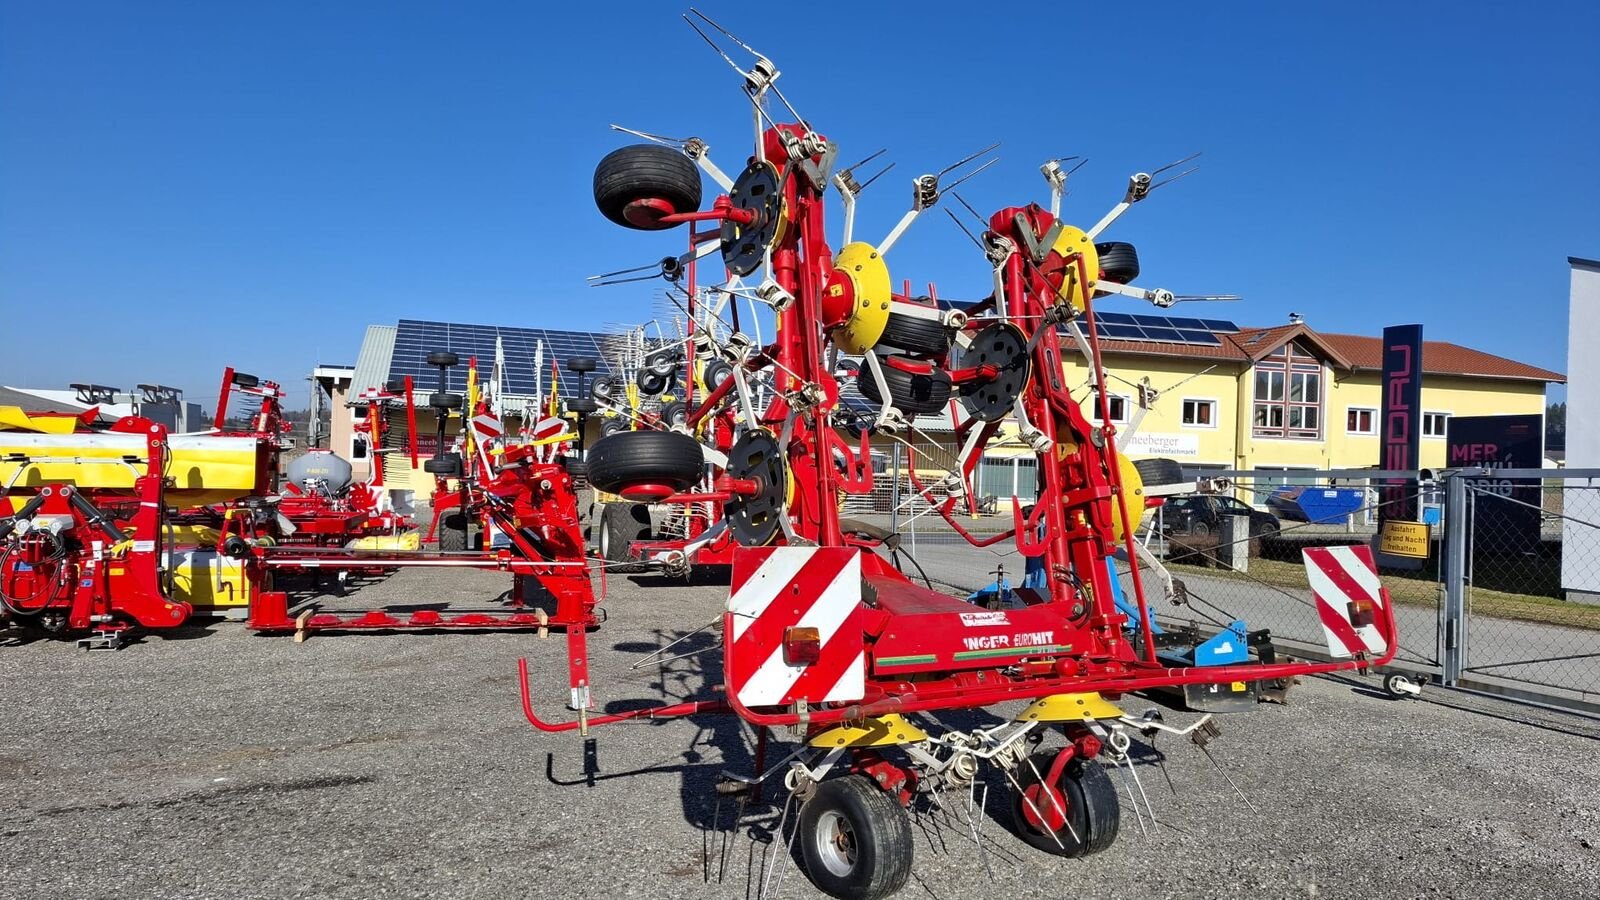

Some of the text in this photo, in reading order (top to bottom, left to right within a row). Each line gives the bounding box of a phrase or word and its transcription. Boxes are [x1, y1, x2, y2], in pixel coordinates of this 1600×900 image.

[1149, 447, 1196, 455] Elektrofachmarkt
[1452, 444, 1497, 461] MER
[1391, 525, 1416, 534] Ausfahrt
[1405, 536, 1426, 544] Nacht
[1387, 544, 1417, 553] freihalten
